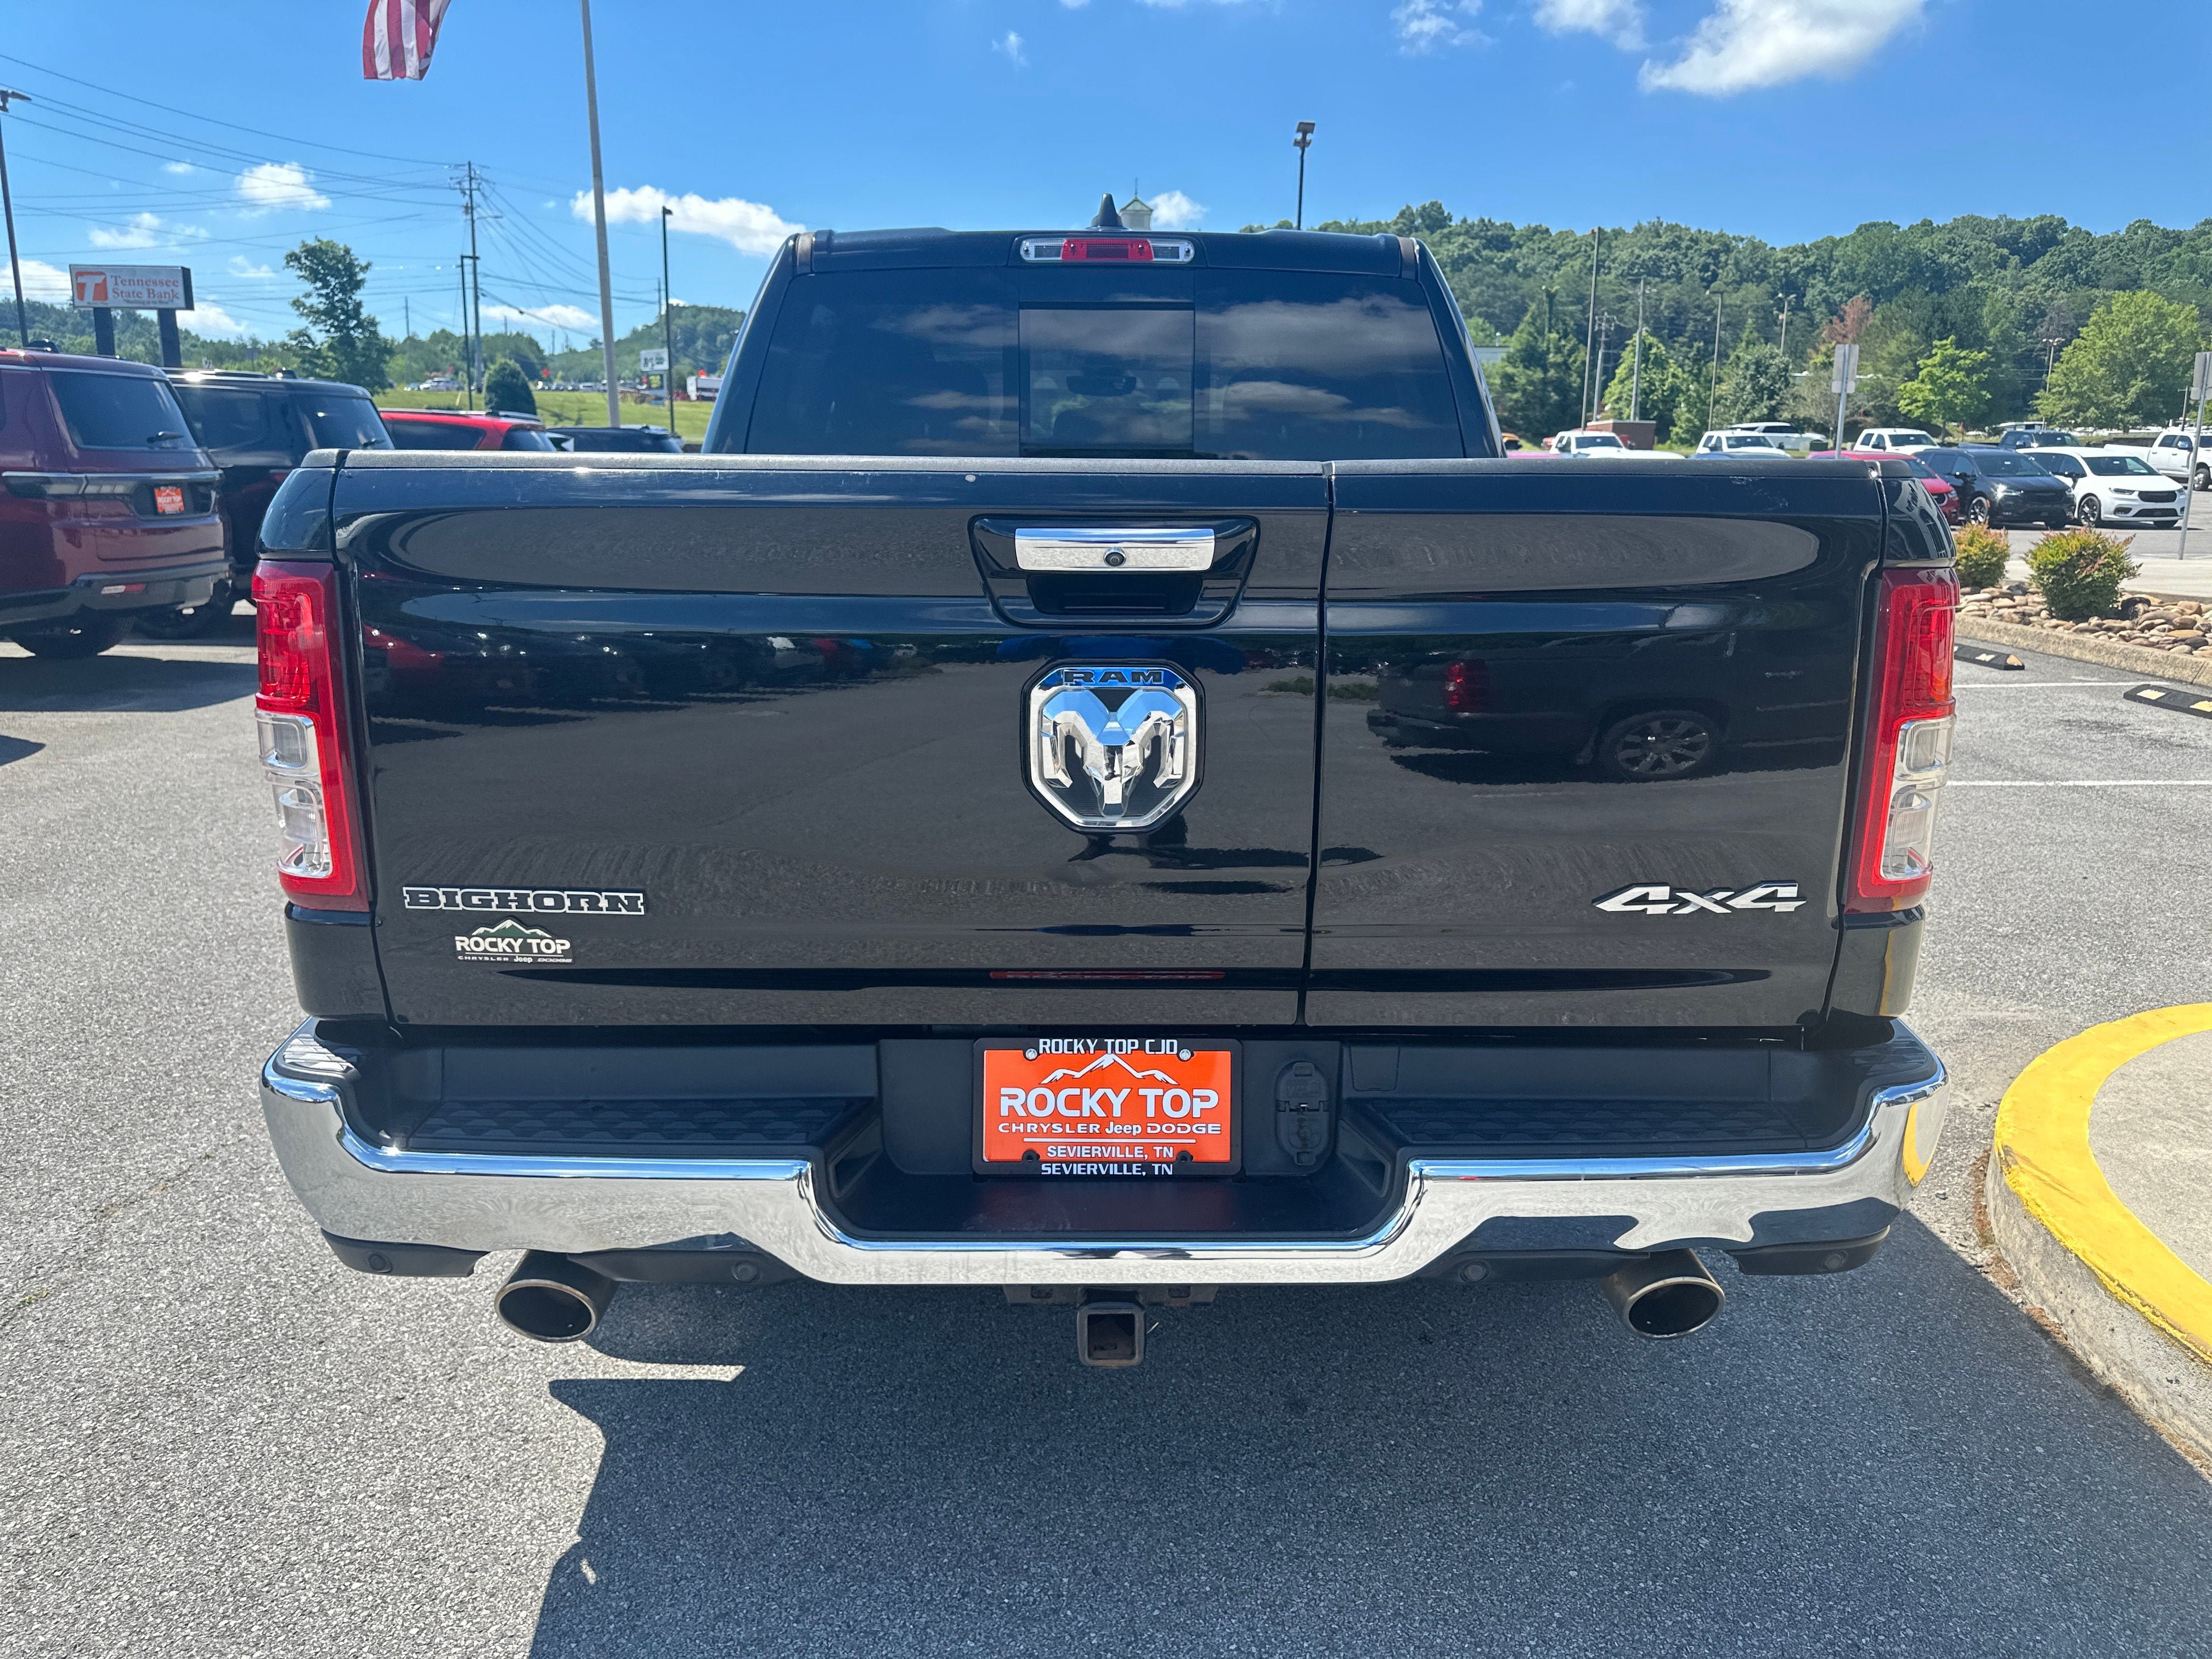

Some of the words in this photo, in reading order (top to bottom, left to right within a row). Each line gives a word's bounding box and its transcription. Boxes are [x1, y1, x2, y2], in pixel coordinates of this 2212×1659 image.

[111, 275, 179, 287] Tennessee
[112, 287, 142, 299] State
[146, 288, 179, 300] Bank
[1063, 670, 1164, 684] RAM
[403, 887, 645, 915] BIGHORN
[1592, 881, 1807, 914] 4x4
[455, 936, 523, 953] ROCKY
[527, 939, 571, 954] TOP
[1039, 1039, 1098, 1054] ROCKY
[1104, 1039, 1139, 1054] TOP
[1146, 1039, 1178, 1054] CJD
[1000, 1087, 1132, 1118] ROCKY
[1138, 1087, 1219, 1119] TOP
[998, 1122, 1101, 1134] CHRYSLER
[1105, 1121, 1142, 1136] Jeep
[1147, 1123, 1221, 1135] DODGE
[1047, 1146, 1148, 1160] SEVIERVILLE,
[1153, 1146, 1173, 1159] TN
[1041, 1163, 1146, 1176] SEVIERVILLE,
[1152, 1163, 1173, 1175] TN
